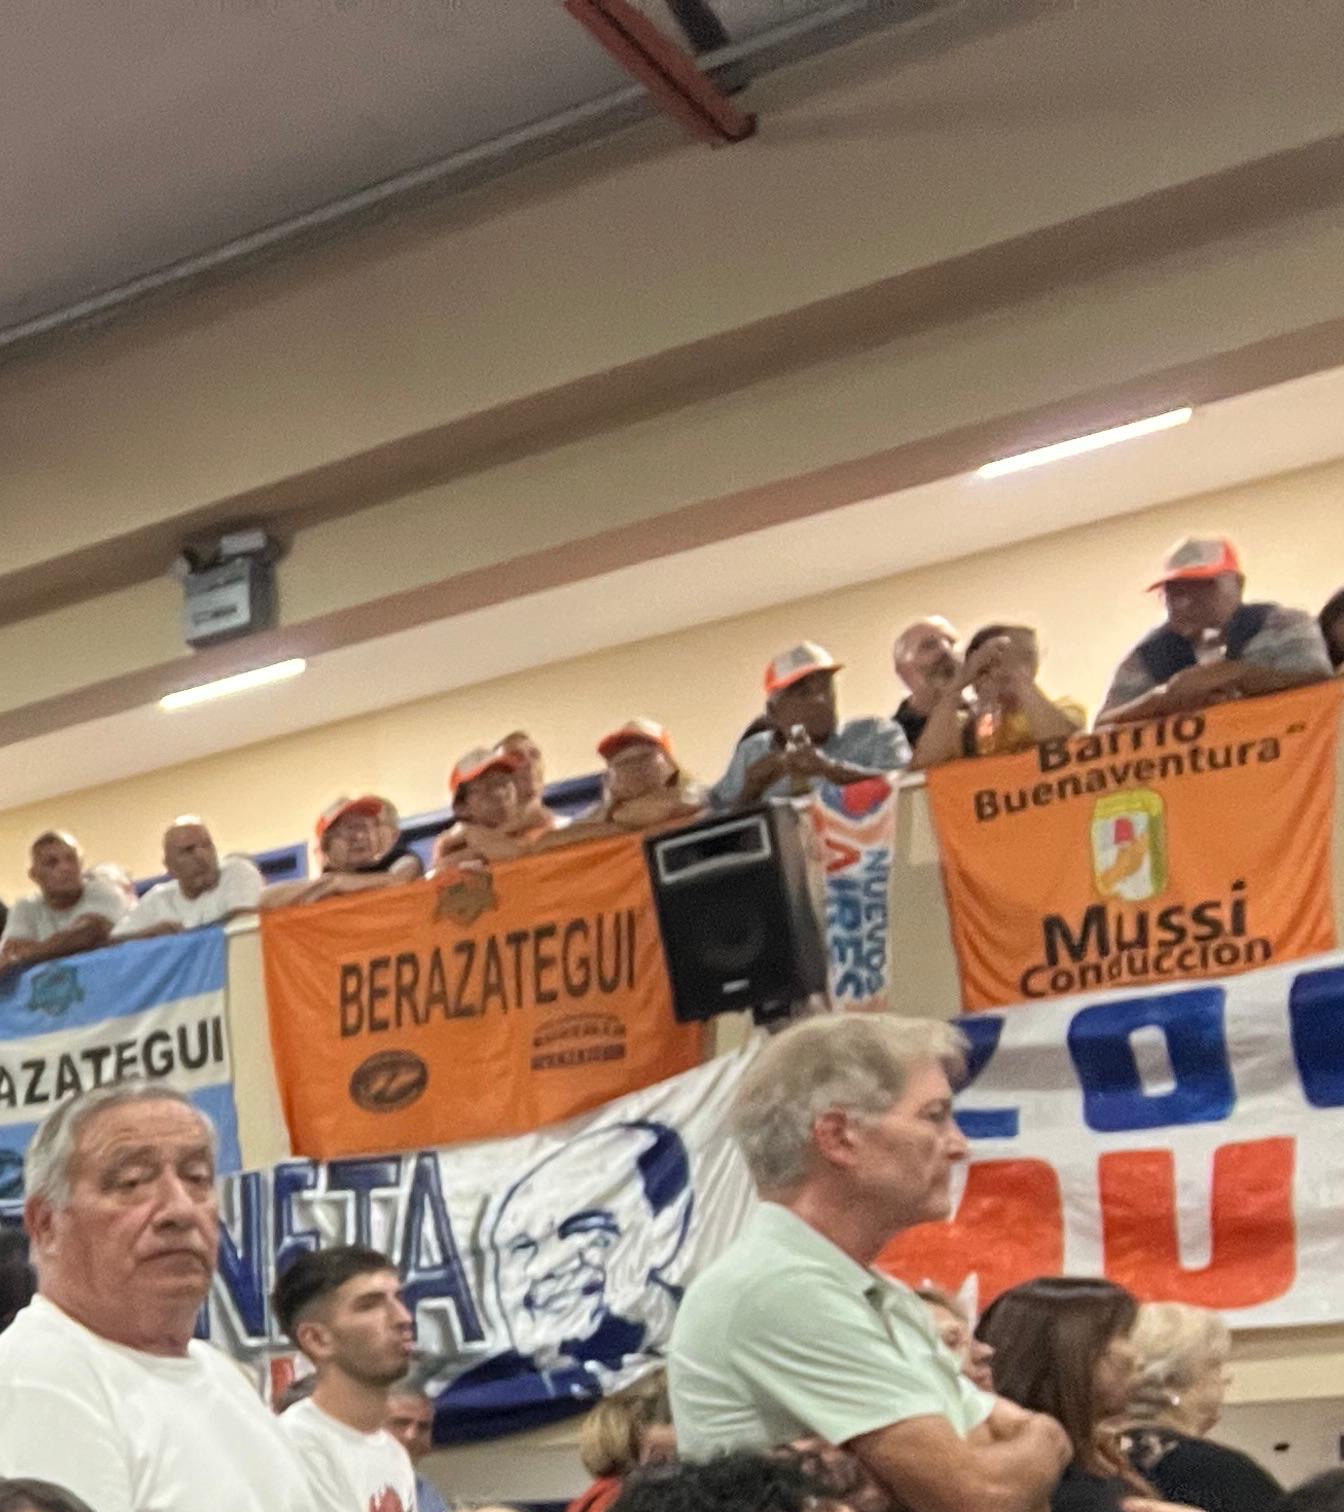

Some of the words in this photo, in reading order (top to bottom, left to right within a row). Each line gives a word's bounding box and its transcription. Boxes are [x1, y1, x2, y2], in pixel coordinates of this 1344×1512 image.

[1037, 714, 1207, 773] Barrio
[823, 836, 863, 998] AIRES
[1042, 879, 1248, 967] Mussi
[339, 909, 637, 1040] BERAZATEGUI
